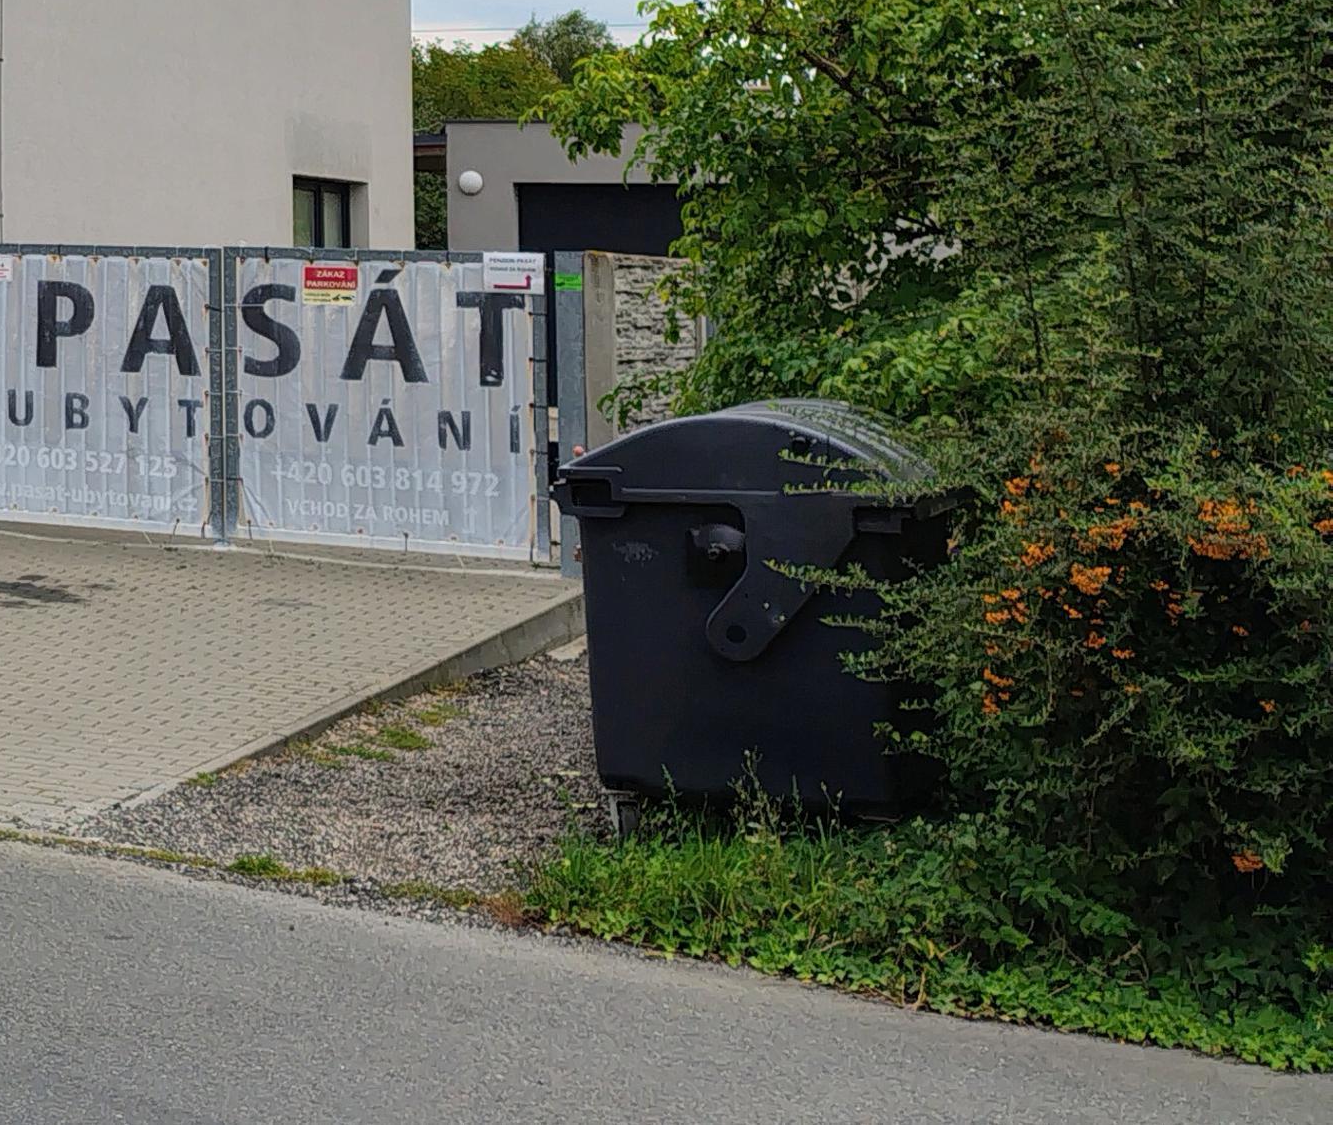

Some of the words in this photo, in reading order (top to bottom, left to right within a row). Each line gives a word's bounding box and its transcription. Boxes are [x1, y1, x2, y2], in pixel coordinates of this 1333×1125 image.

[306, 280, 356, 288] PARKOVÁNÍ
[316, 269, 346, 279] ZÁKAZ
[35, 269, 525, 387] PASÁT
[7, 389, 521, 453] UBYTOVÁNÍ
[36, 447, 77, 471] 603
[85, 451, 127, 475] 527
[135, 454, 177, 477] 125
[272, 461, 333, 486] +420
[340, 464, 386, 490] 603
[395, 467, 443, 493] 814
[451, 471, 500, 497] 972
[286, 498, 349, 519] VCHOD
[353, 503, 378, 522] ZA
[384, 505, 450, 526] ROHEM
